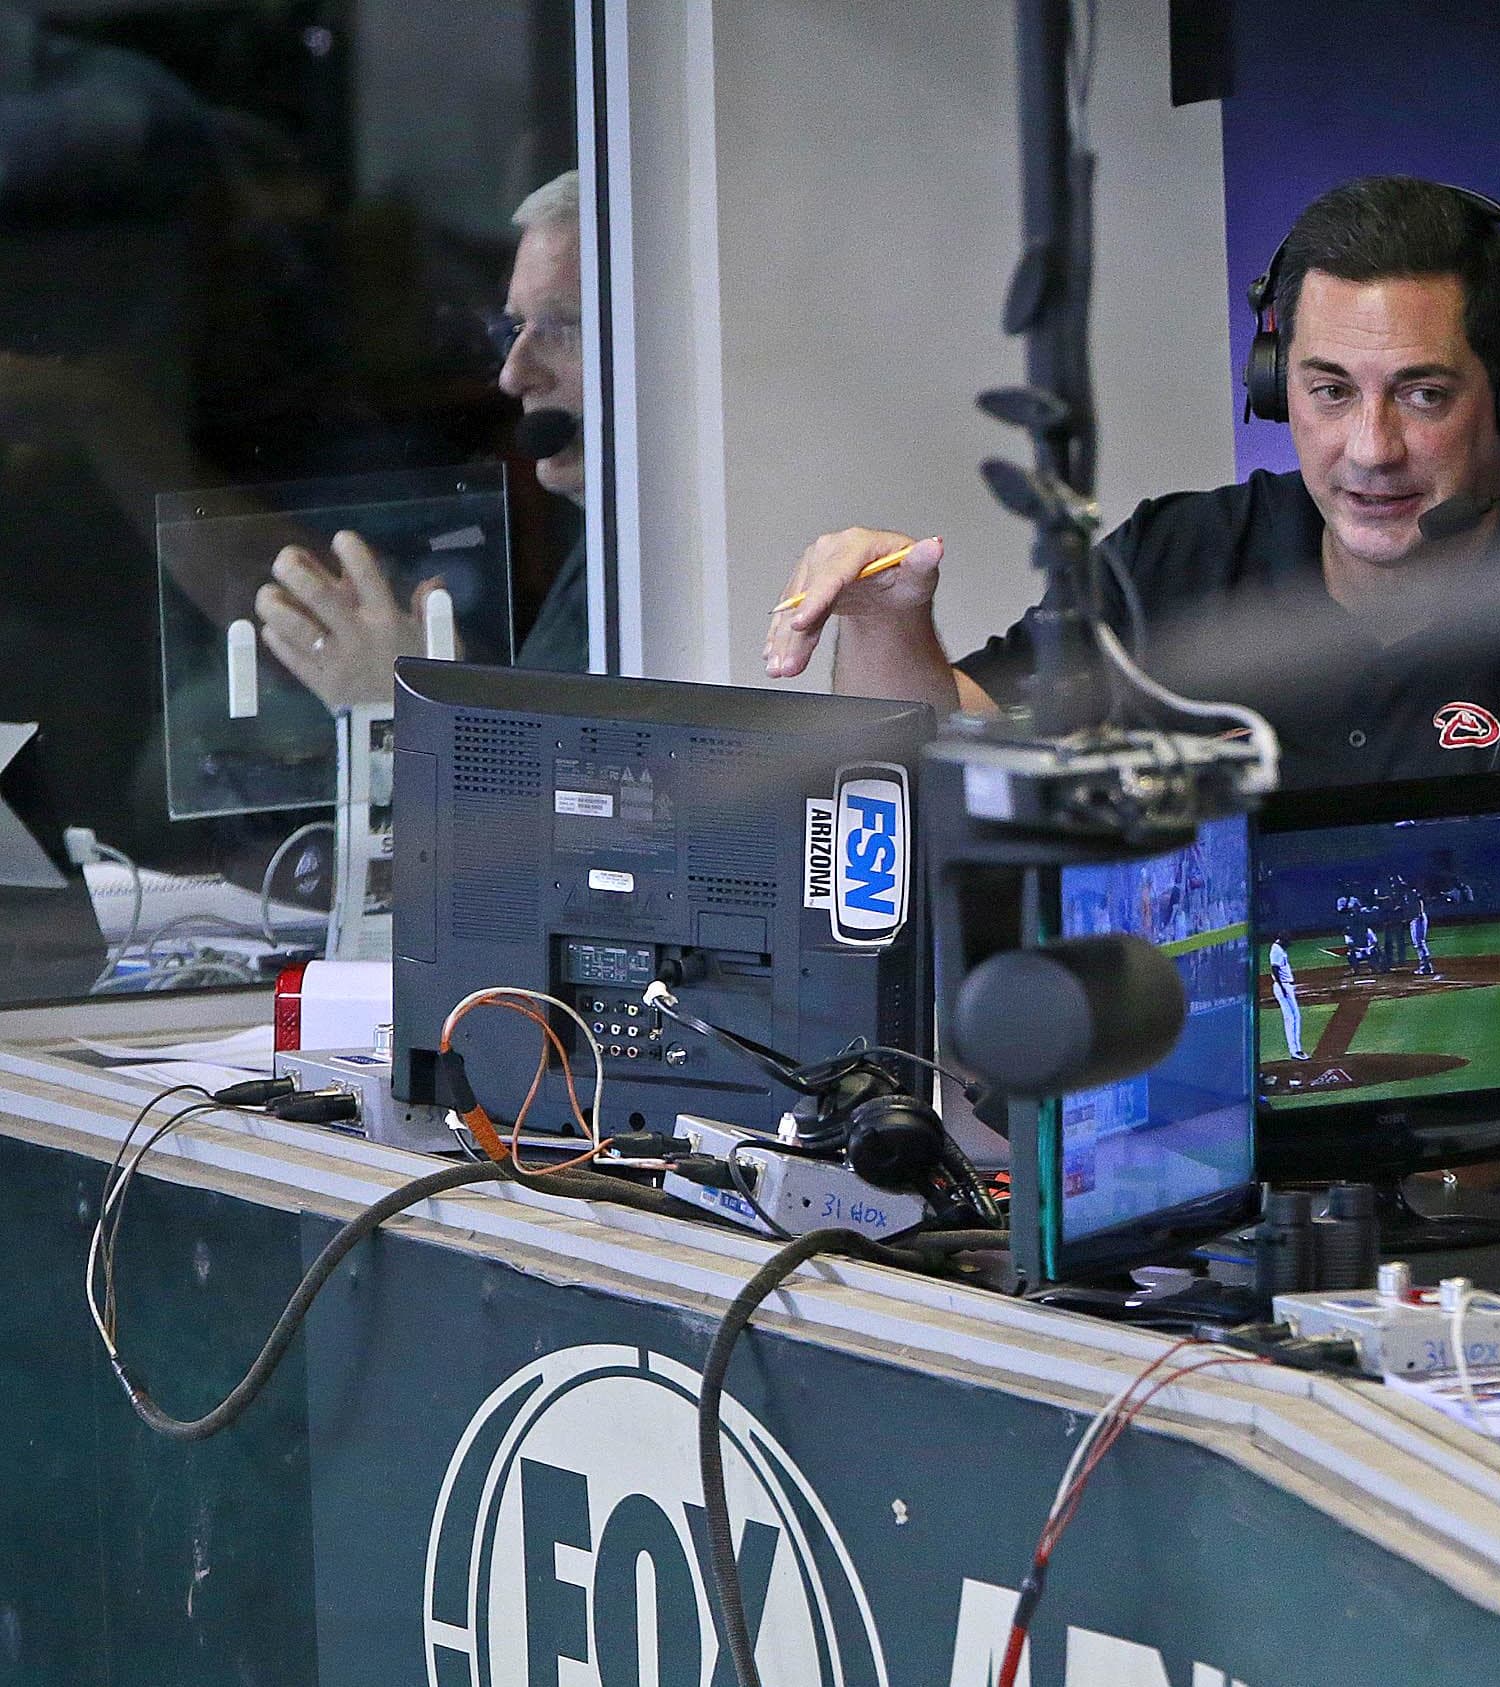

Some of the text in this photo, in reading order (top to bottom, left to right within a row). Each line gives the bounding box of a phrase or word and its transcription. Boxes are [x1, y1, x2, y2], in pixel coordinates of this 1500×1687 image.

[809, 808, 832, 898] ARIZONA
[845, 794, 896, 916] FSN
[821, 1193, 841, 1219] 31
[520, 1456, 781, 1687] FOX
